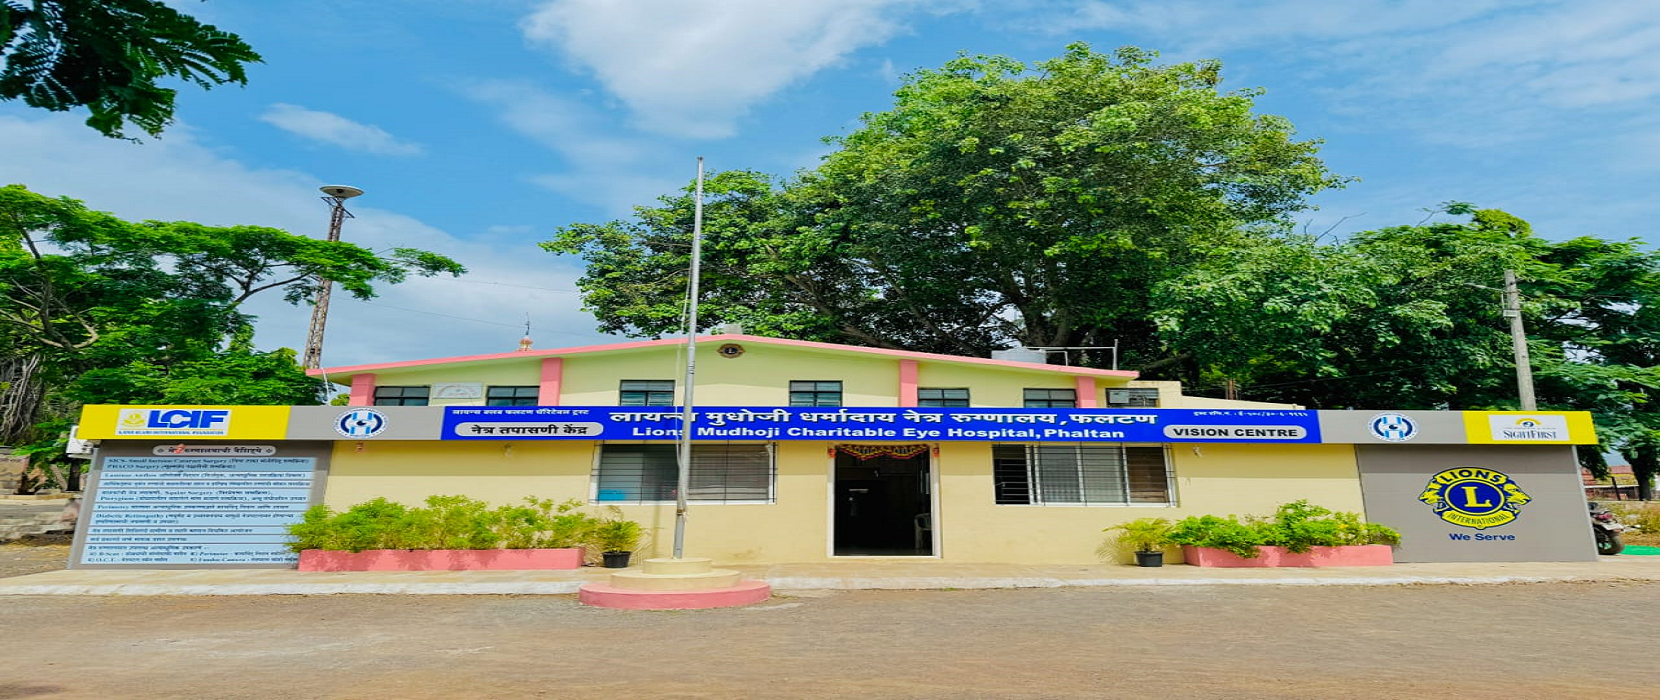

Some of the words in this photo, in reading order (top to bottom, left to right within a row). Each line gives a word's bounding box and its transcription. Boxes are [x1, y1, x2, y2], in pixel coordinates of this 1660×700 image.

[147, 410, 228, 428] LCIF
[705, 409, 791, 426] मुधोजी
[799, 409, 897, 423] धर्मादाय
[902, 409, 944, 423] नेत्र
[471, 424, 495, 434] नेत्र
[499, 424, 559, 434] तपासणी
[562, 423, 588, 434] केंद्र
[697, 427, 780, 439] Mudhoji
[786, 428, 896, 437] Charitable
[903, 428, 940, 439] Eye
[1173, 428, 1229, 437] VISION
[1234, 429, 1298, 437] CENTRE
[1440, 469, 1502, 482] LIONS
[1461, 486, 1493, 508] L
[1449, 513, 1509, 525] INTERNATIONAL
[1449, 533, 1471, 541] We
[1474, 533, 1516, 541] Serve
